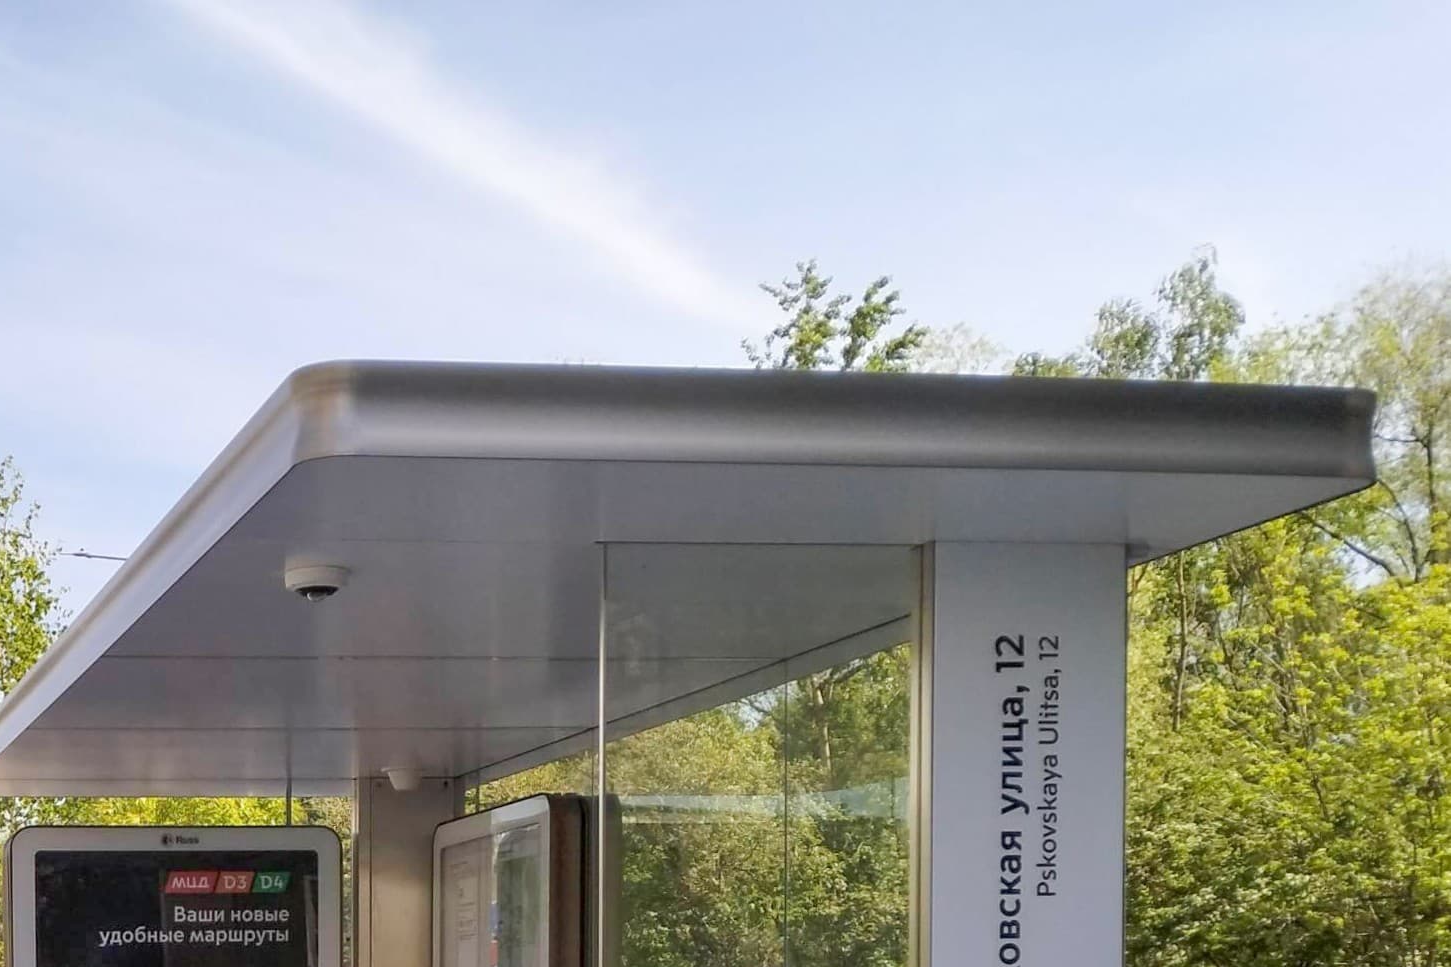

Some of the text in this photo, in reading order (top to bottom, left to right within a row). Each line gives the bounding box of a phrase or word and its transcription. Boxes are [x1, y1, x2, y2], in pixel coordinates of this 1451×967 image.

[995, 634, 1025, 673] 12
[1000, 684, 1030, 815] улица,
[1037, 635, 1063, 897] Pskovskaya Ulitsa, 12
[171, 874, 284, 890] МЦД D3 D4
[174, 905, 290, 922] Ваши новые
[98, 925, 290, 947] удобные маршруты
